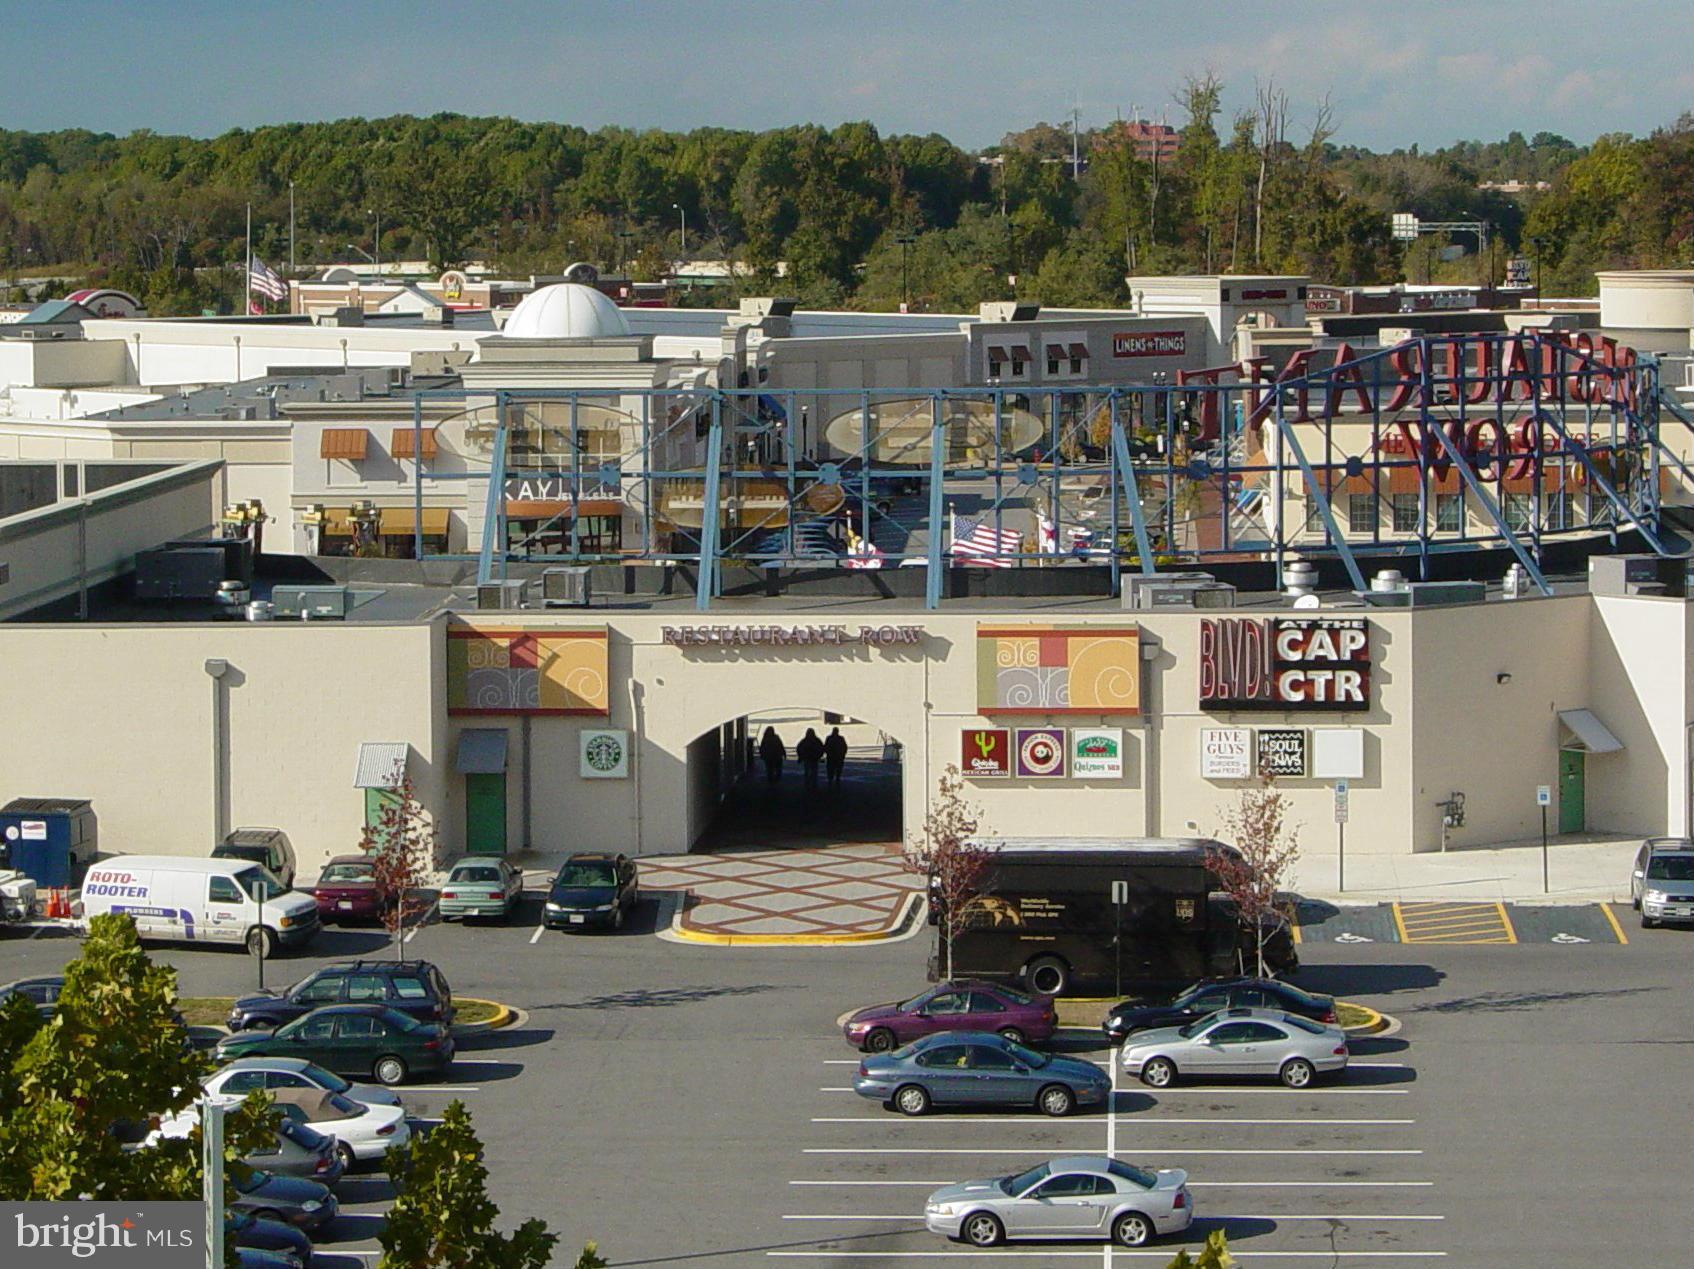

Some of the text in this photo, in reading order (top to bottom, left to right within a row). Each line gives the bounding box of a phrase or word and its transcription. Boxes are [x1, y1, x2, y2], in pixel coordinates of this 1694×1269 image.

[1115, 338, 1146, 352] LINENS
[1279, 621, 1365, 629] AT THE
[661, 625, 925, 645] RESTAURANT ROW
[1276, 629, 1366, 661] CAP
[1200, 618, 1271, 699] BLVD!
[1278, 669, 1365, 702] CTR
[1209, 731, 1242, 742] FIVE
[1206, 743, 1245, 755] GUYS
[1269, 740, 1303, 752] SOUL
[90, 871, 137, 884] ROTO-
[86, 884, 148, 898] ROOTER
